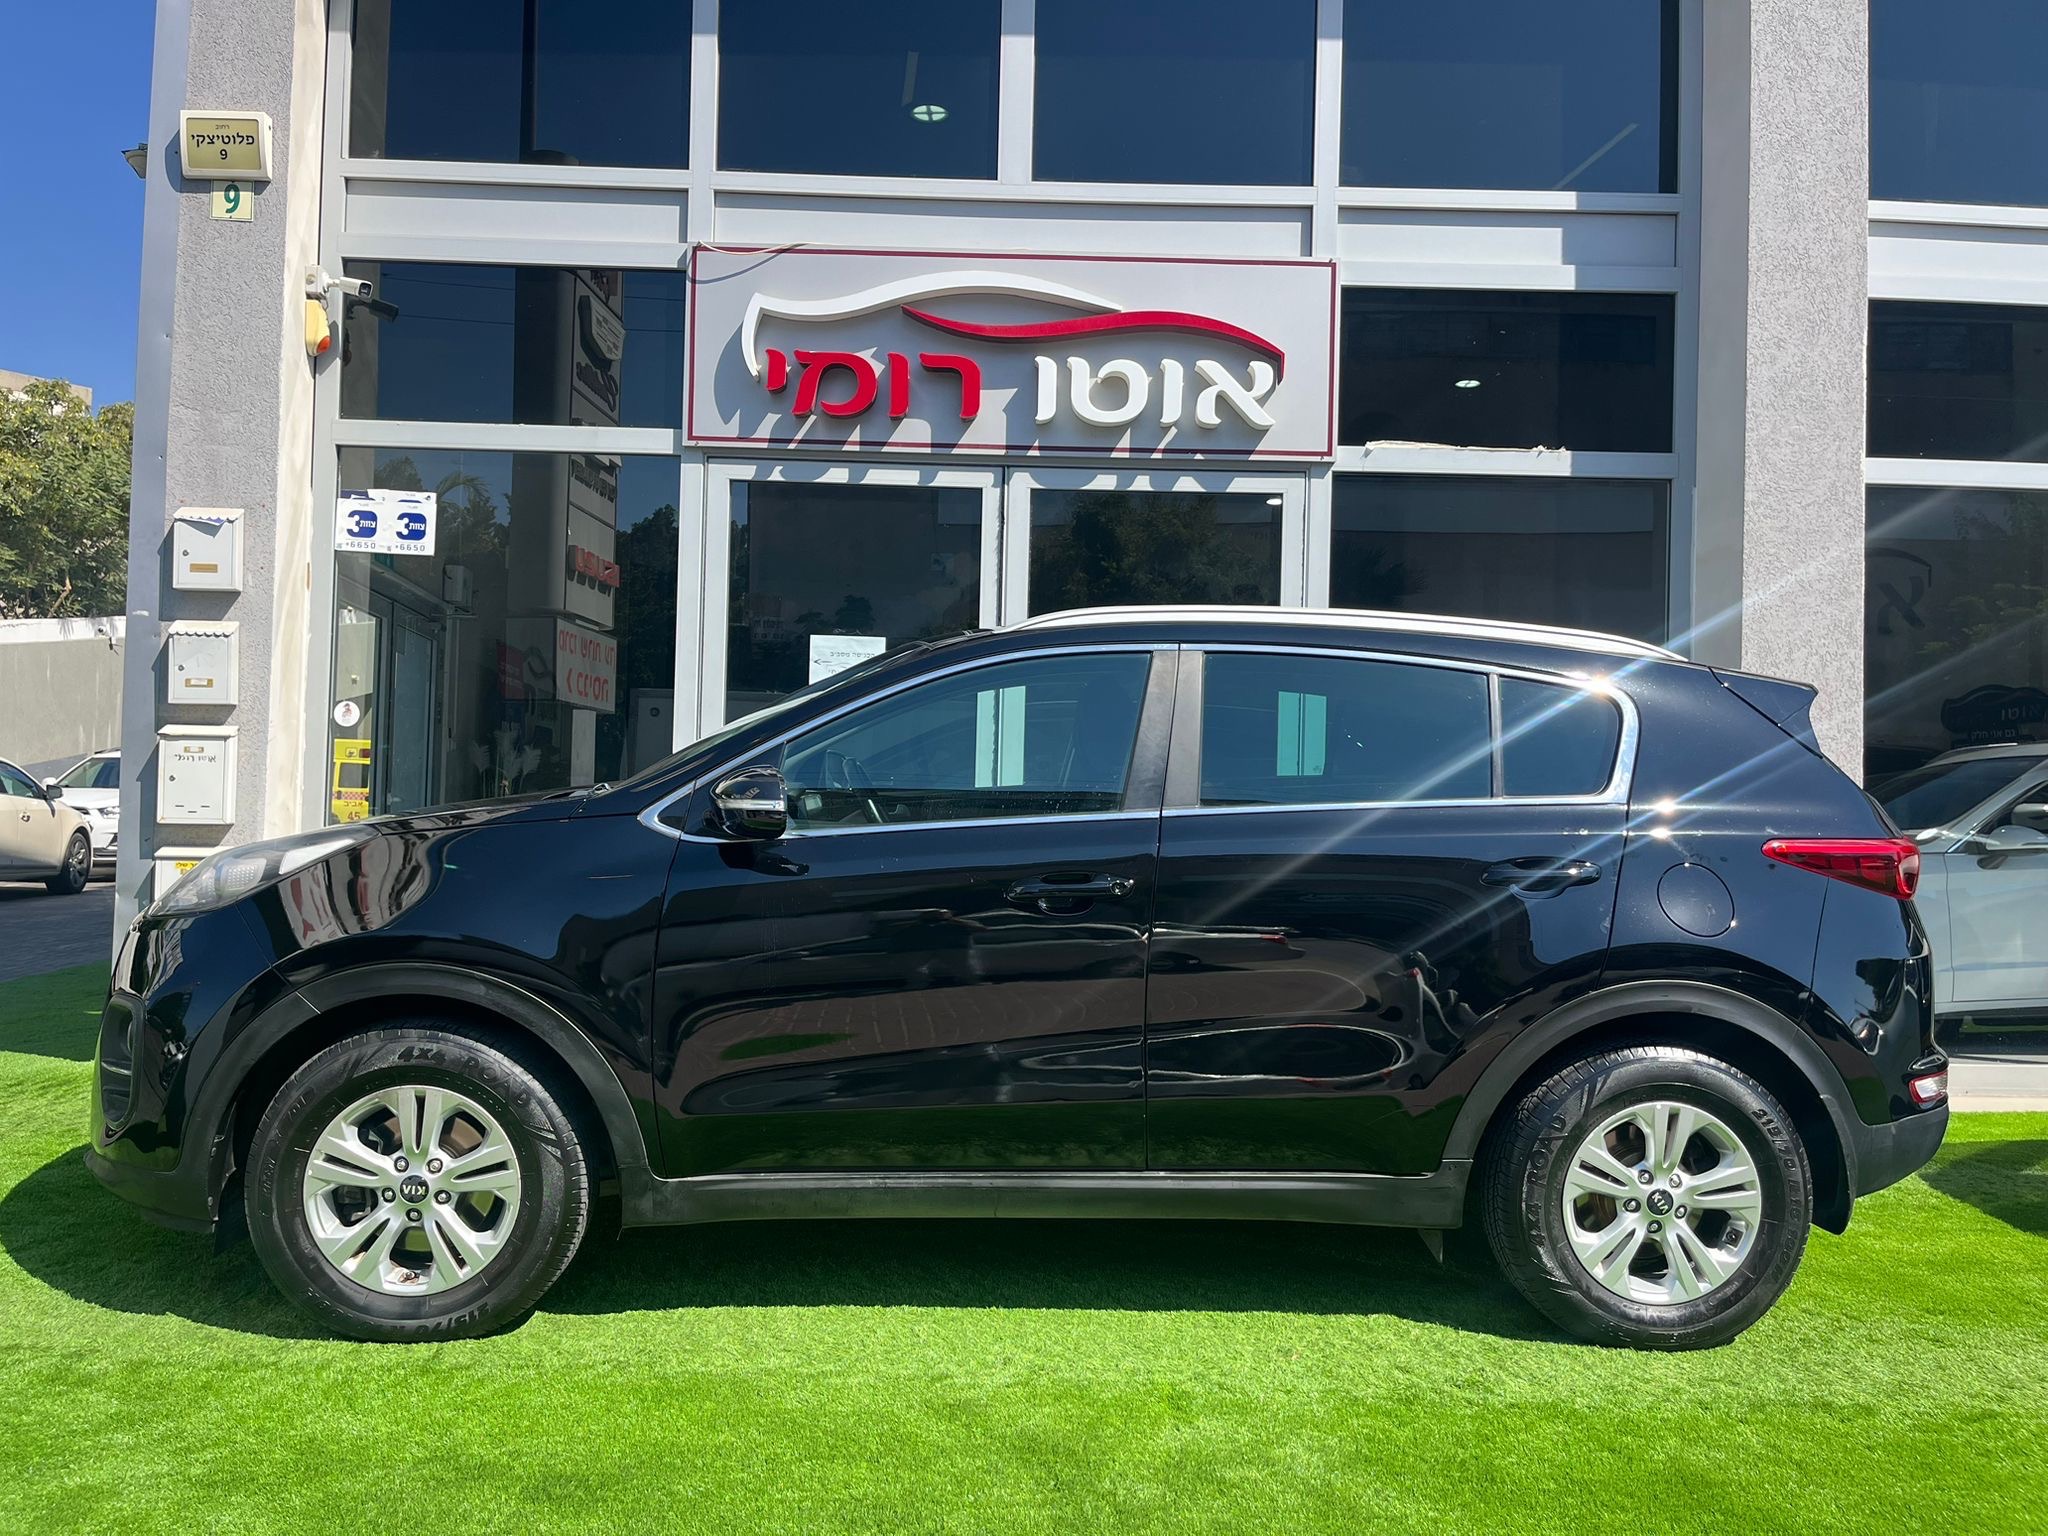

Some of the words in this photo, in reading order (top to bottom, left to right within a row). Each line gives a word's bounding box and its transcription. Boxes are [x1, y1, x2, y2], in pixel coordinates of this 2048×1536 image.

[191, 132, 255, 148] פלוטיצקי
[219, 148, 228, 160] 9
[223, 183, 241, 214] 9
[765, 347, 982, 421] רומי
[1034, 355, 1277, 431] אוטו
[359, 519, 377, 528] צוות
[408, 522, 426, 531] צוות
[402, 1184, 427, 1196] KIA
[1651, 1192, 1669, 1214] KIA
